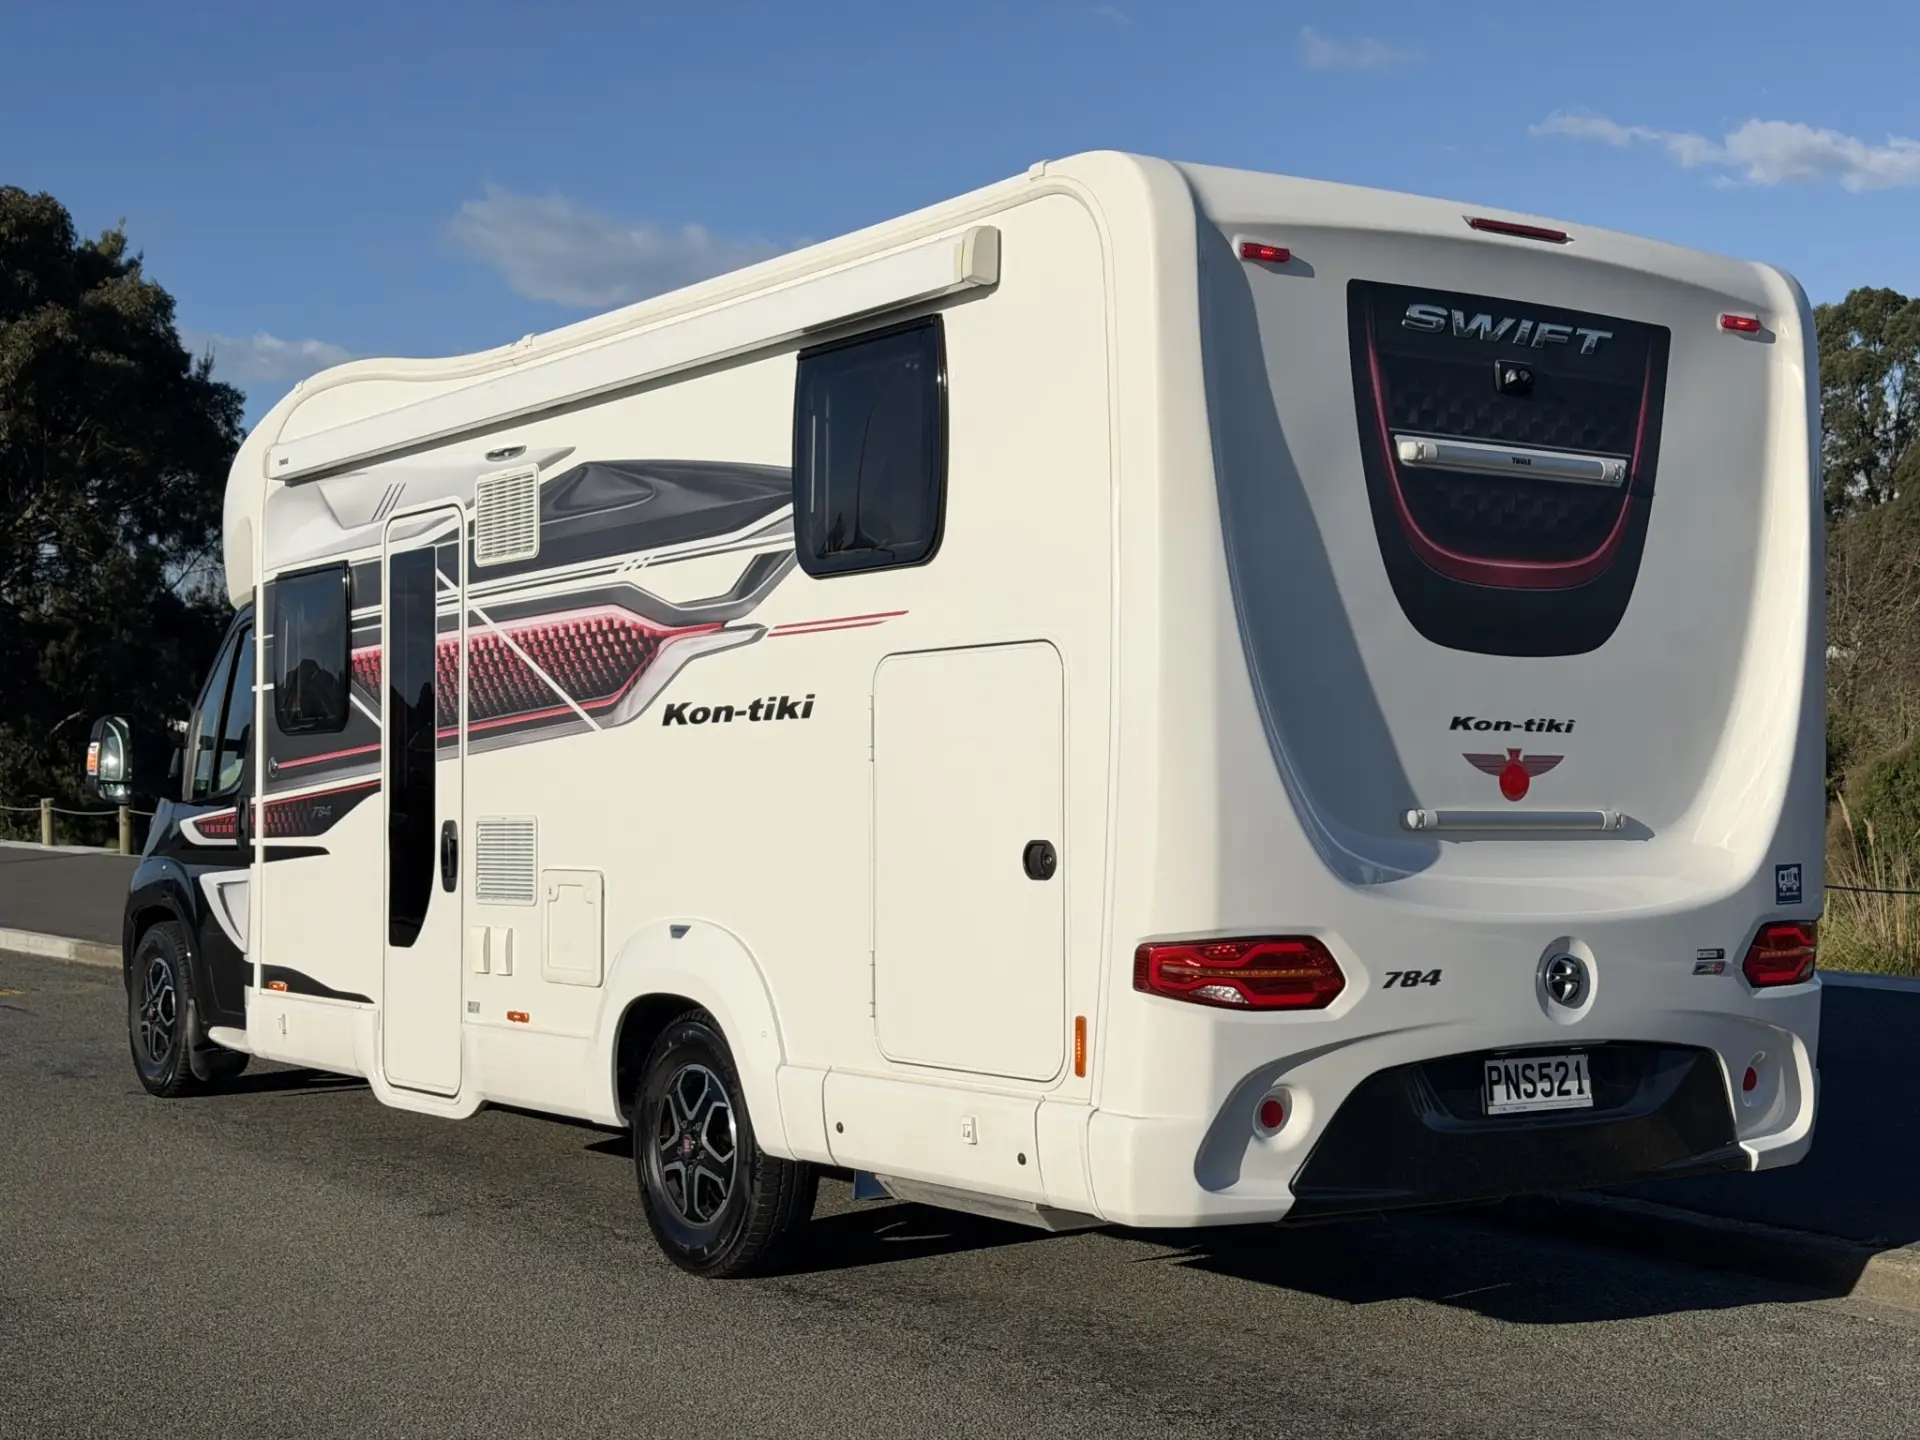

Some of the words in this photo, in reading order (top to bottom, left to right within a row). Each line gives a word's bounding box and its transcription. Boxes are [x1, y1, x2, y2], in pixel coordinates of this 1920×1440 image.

[1401, 303, 1613, 355] SWIFT
[661, 693, 815, 726] Kon-tiki
[1449, 716, 1576, 733] Kon-tiki
[1383, 968, 1442, 989] 784
[1487, 1060, 1586, 1103] PNS521
